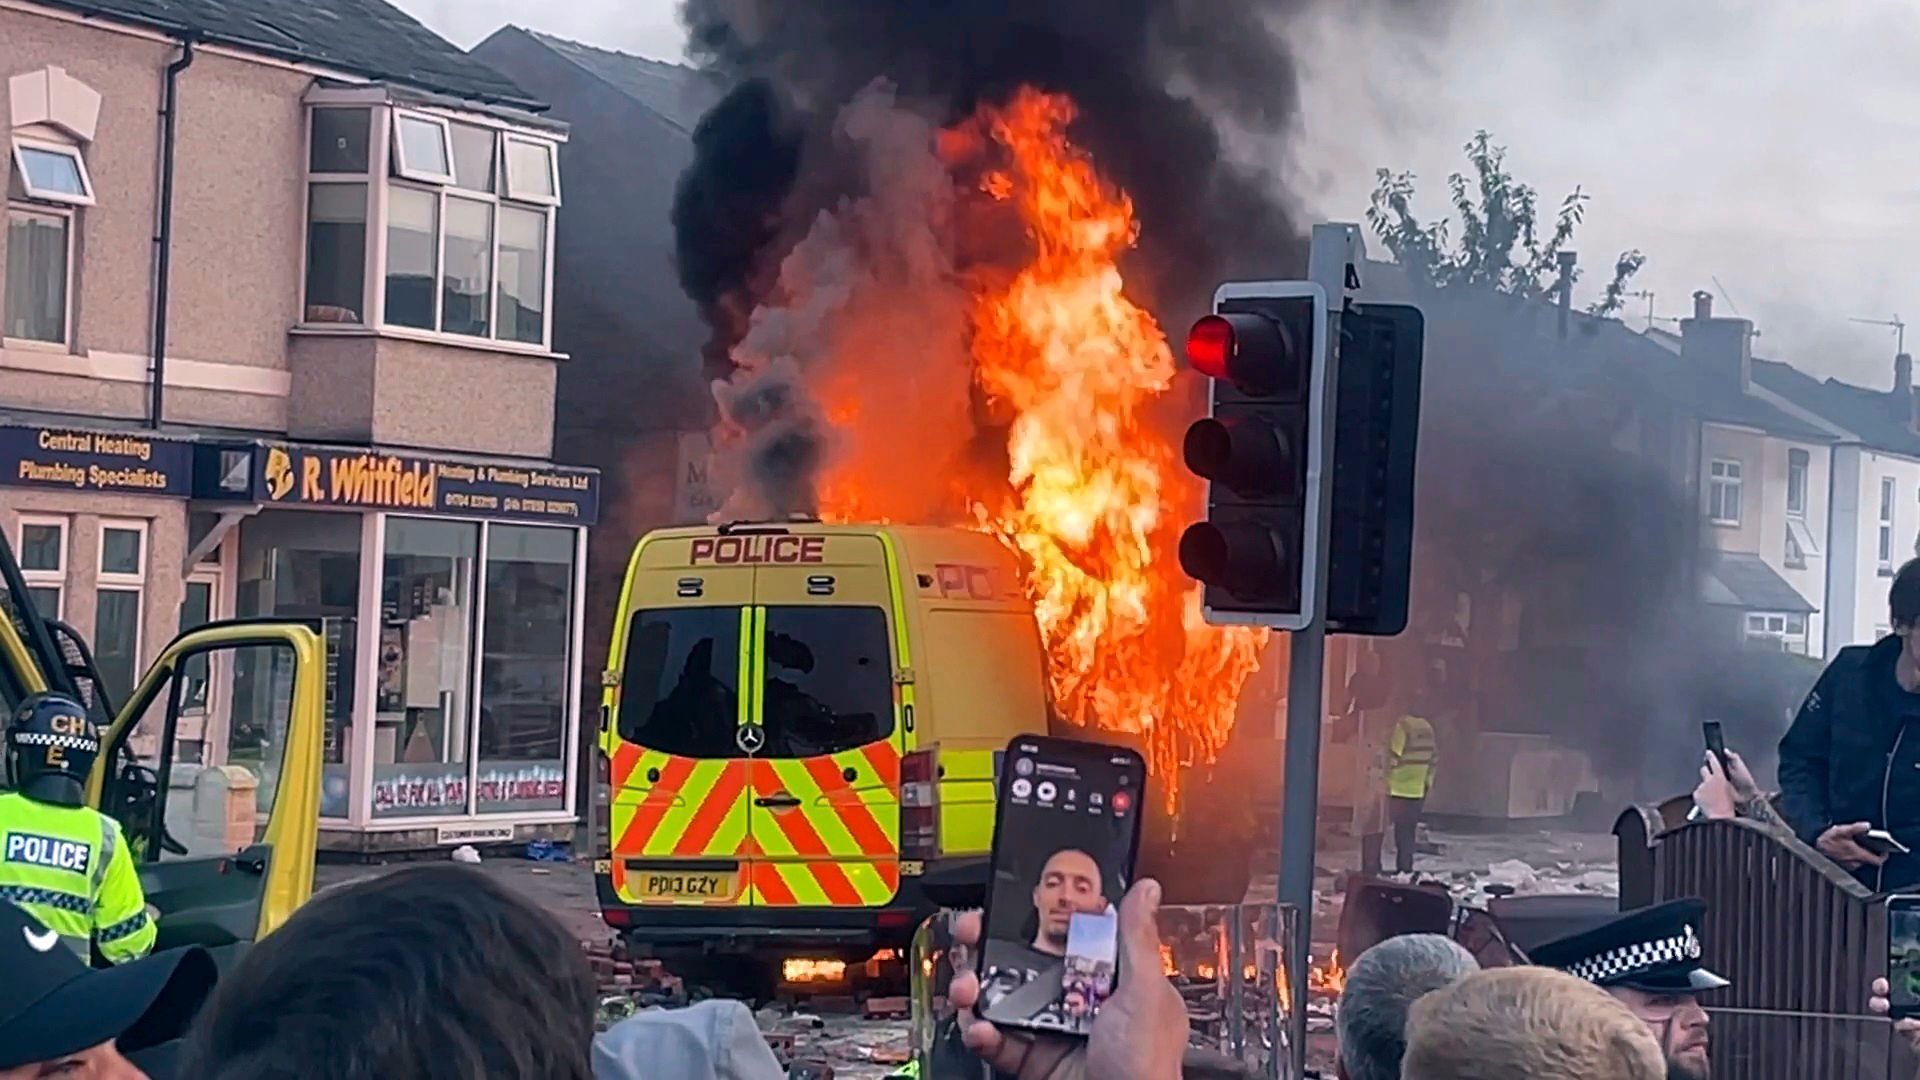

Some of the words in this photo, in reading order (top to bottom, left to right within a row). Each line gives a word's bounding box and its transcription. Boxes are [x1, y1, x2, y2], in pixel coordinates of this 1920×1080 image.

[39, 431, 91, 451] Central
[95, 436, 150, 460] Heating
[19, 460, 85, 487] Plumbing
[89, 465, 167, 488] Specialists
[302, 456, 325, 501] R.
[331, 455, 435, 507] Whitfield
[531, 472, 570, 488] Services
[573, 475, 588, 490] Ltd
[689, 536, 826, 566] POLICE
[51, 715, 86, 737] CH
[46, 744, 65, 766] E
[7, 834, 89, 871] POLICE
[687, 876, 718, 893] GZY
